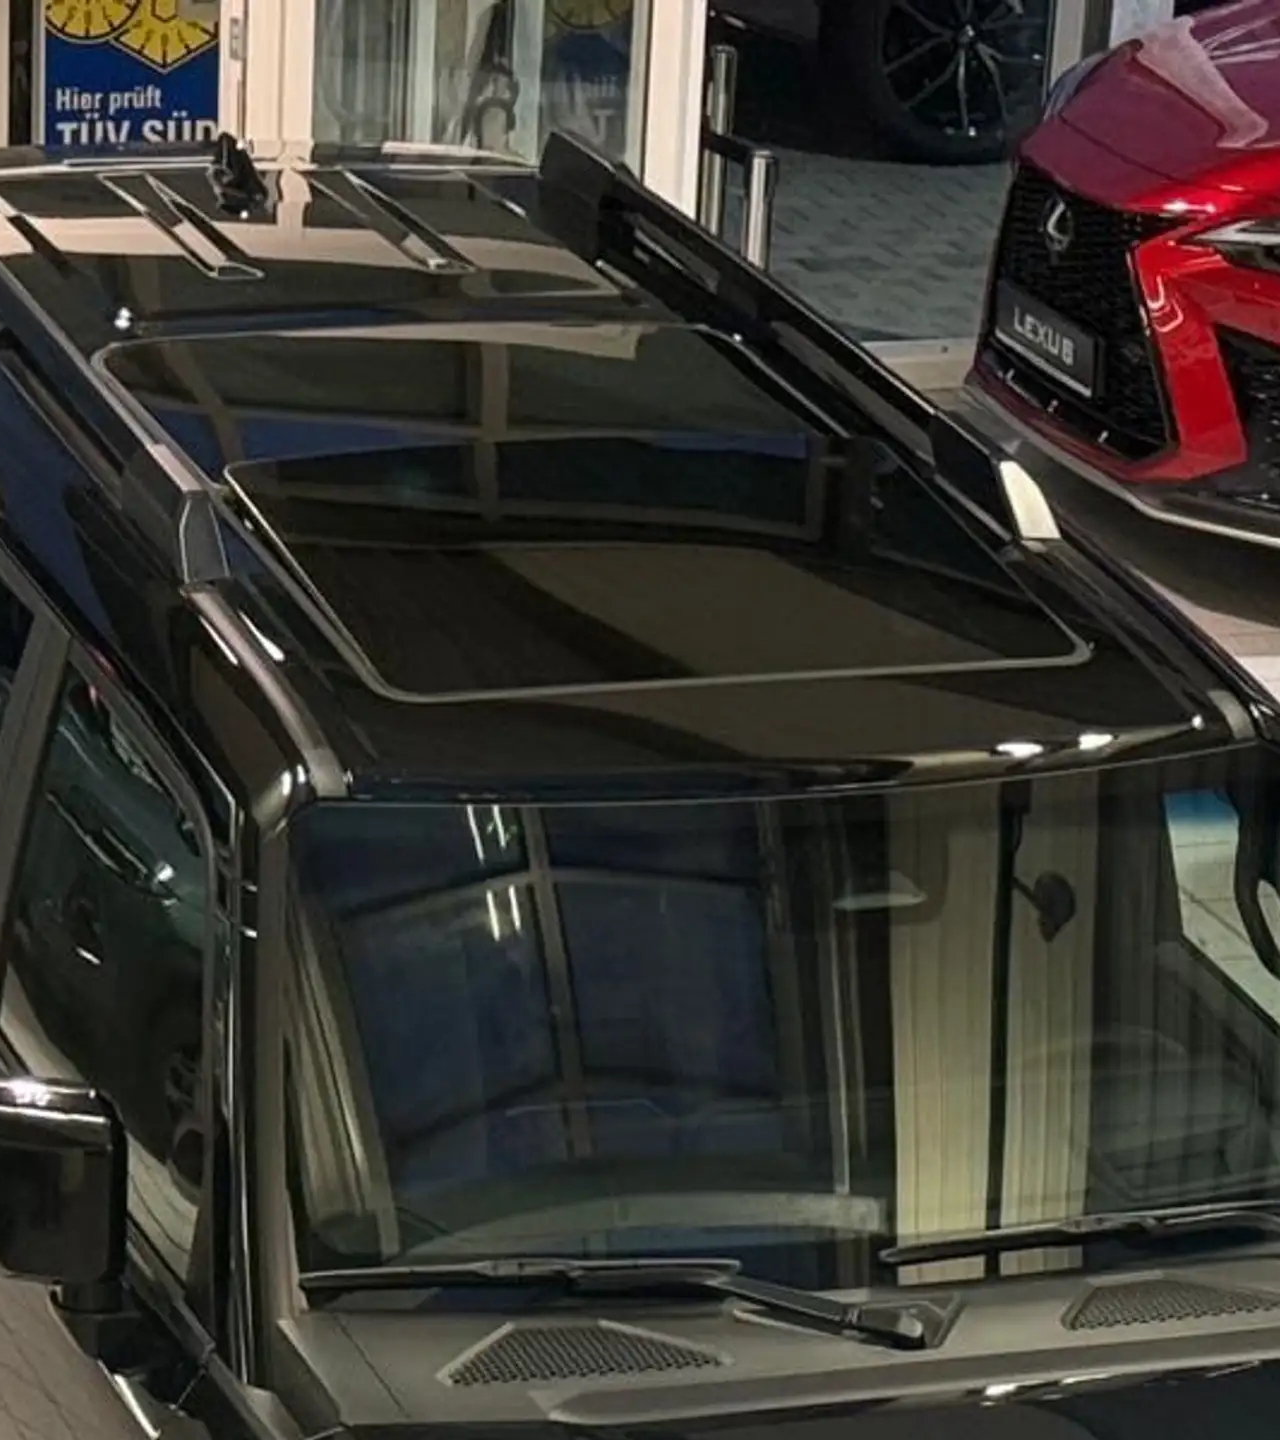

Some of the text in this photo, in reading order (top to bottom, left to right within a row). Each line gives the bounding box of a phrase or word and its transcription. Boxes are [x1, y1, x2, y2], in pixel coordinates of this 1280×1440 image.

[55, 84, 163, 116] Hier prüft
[55, 111, 131, 147] TÜV
